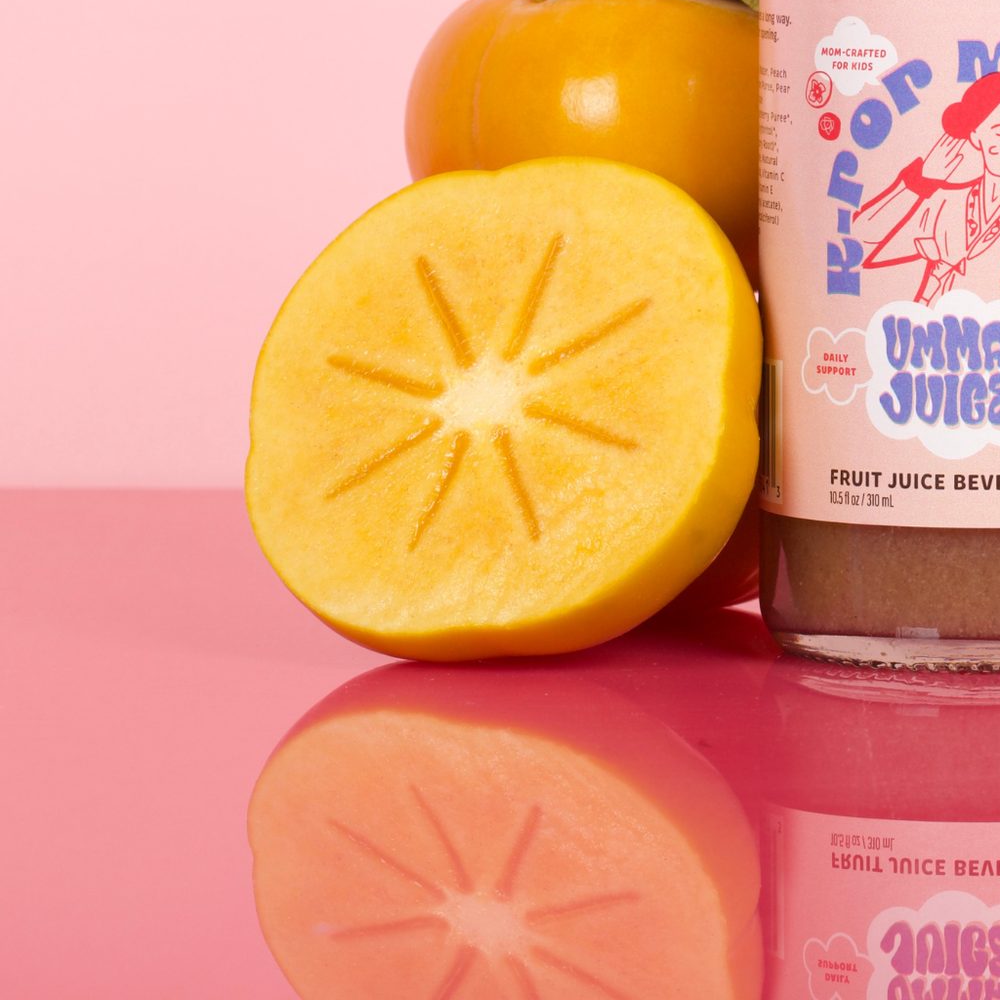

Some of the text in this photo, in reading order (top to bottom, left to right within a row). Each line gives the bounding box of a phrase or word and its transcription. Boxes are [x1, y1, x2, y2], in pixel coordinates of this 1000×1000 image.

[776, 15, 792, 27] way.
[821, 47, 887, 58] MOM-CRAFTED
[832, 61, 873, 72] FOR KIDS
[770, 67, 787, 78] Peach
[775, 83, 790, 94] Pear
[780, 172, 785, 182] C
[827, 59, 932, 296] K-POP
[823, 352, 849, 363] DAILY
[816, 365, 857, 376] SUPPORT
[830, 469, 883, 488] FRUIT
[887, 473, 945, 490] JUICE
[829, 491, 844, 505] 10.5
[844, 491, 850, 505] fl
[851, 494, 860, 506] oz
[866, 494, 880, 507] 310
[882, 495, 895, 508] mL
